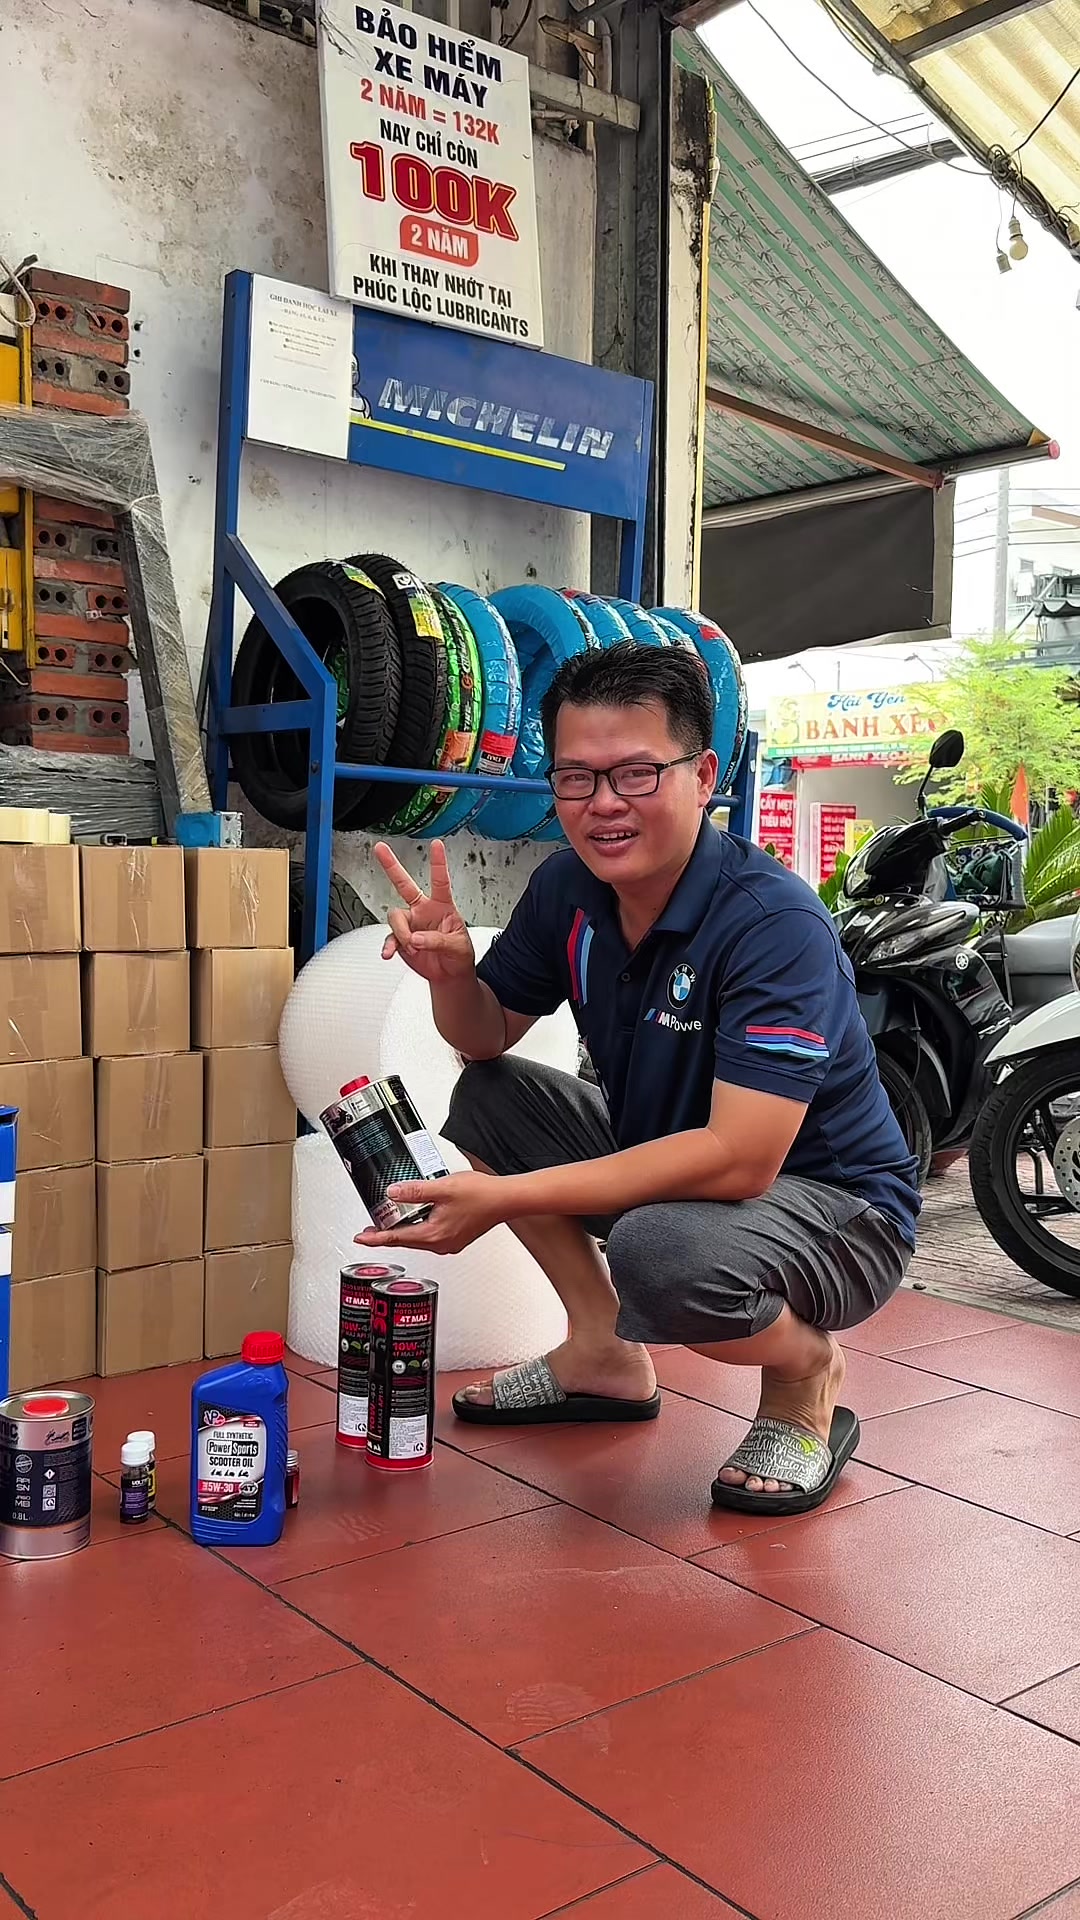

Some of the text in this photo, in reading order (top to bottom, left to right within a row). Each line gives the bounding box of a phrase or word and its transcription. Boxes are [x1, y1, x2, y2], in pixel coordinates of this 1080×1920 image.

[355, 6, 502, 82] BẢO HIỂM
[374, 47, 488, 109] XE MÁY
[360, 78, 373, 102] 2
[380, 84, 426, 121] NĂM
[452, 110, 500, 145] 132K
[380, 118, 478, 169] NAY CHỈ CÒN
[350, 140, 519, 242] 100K
[411, 223, 469, 260] 2 NĂM
[352, 275, 528, 337] PHÚC LỘC LUBRICANTS
[369, 253, 512, 310] KHI THAY NHỚT TẠI
[377, 377, 615, 460] MICHELIN
[806, 711, 880, 740] BÁNH
[400, 1315, 411, 1323] 4T
[208, 1456, 254, 1468] SCOOTER OIL
[213, 1430, 254, 1440] FULL SYNTHETIC
[207, 1481, 234, 1493] 5W-30
